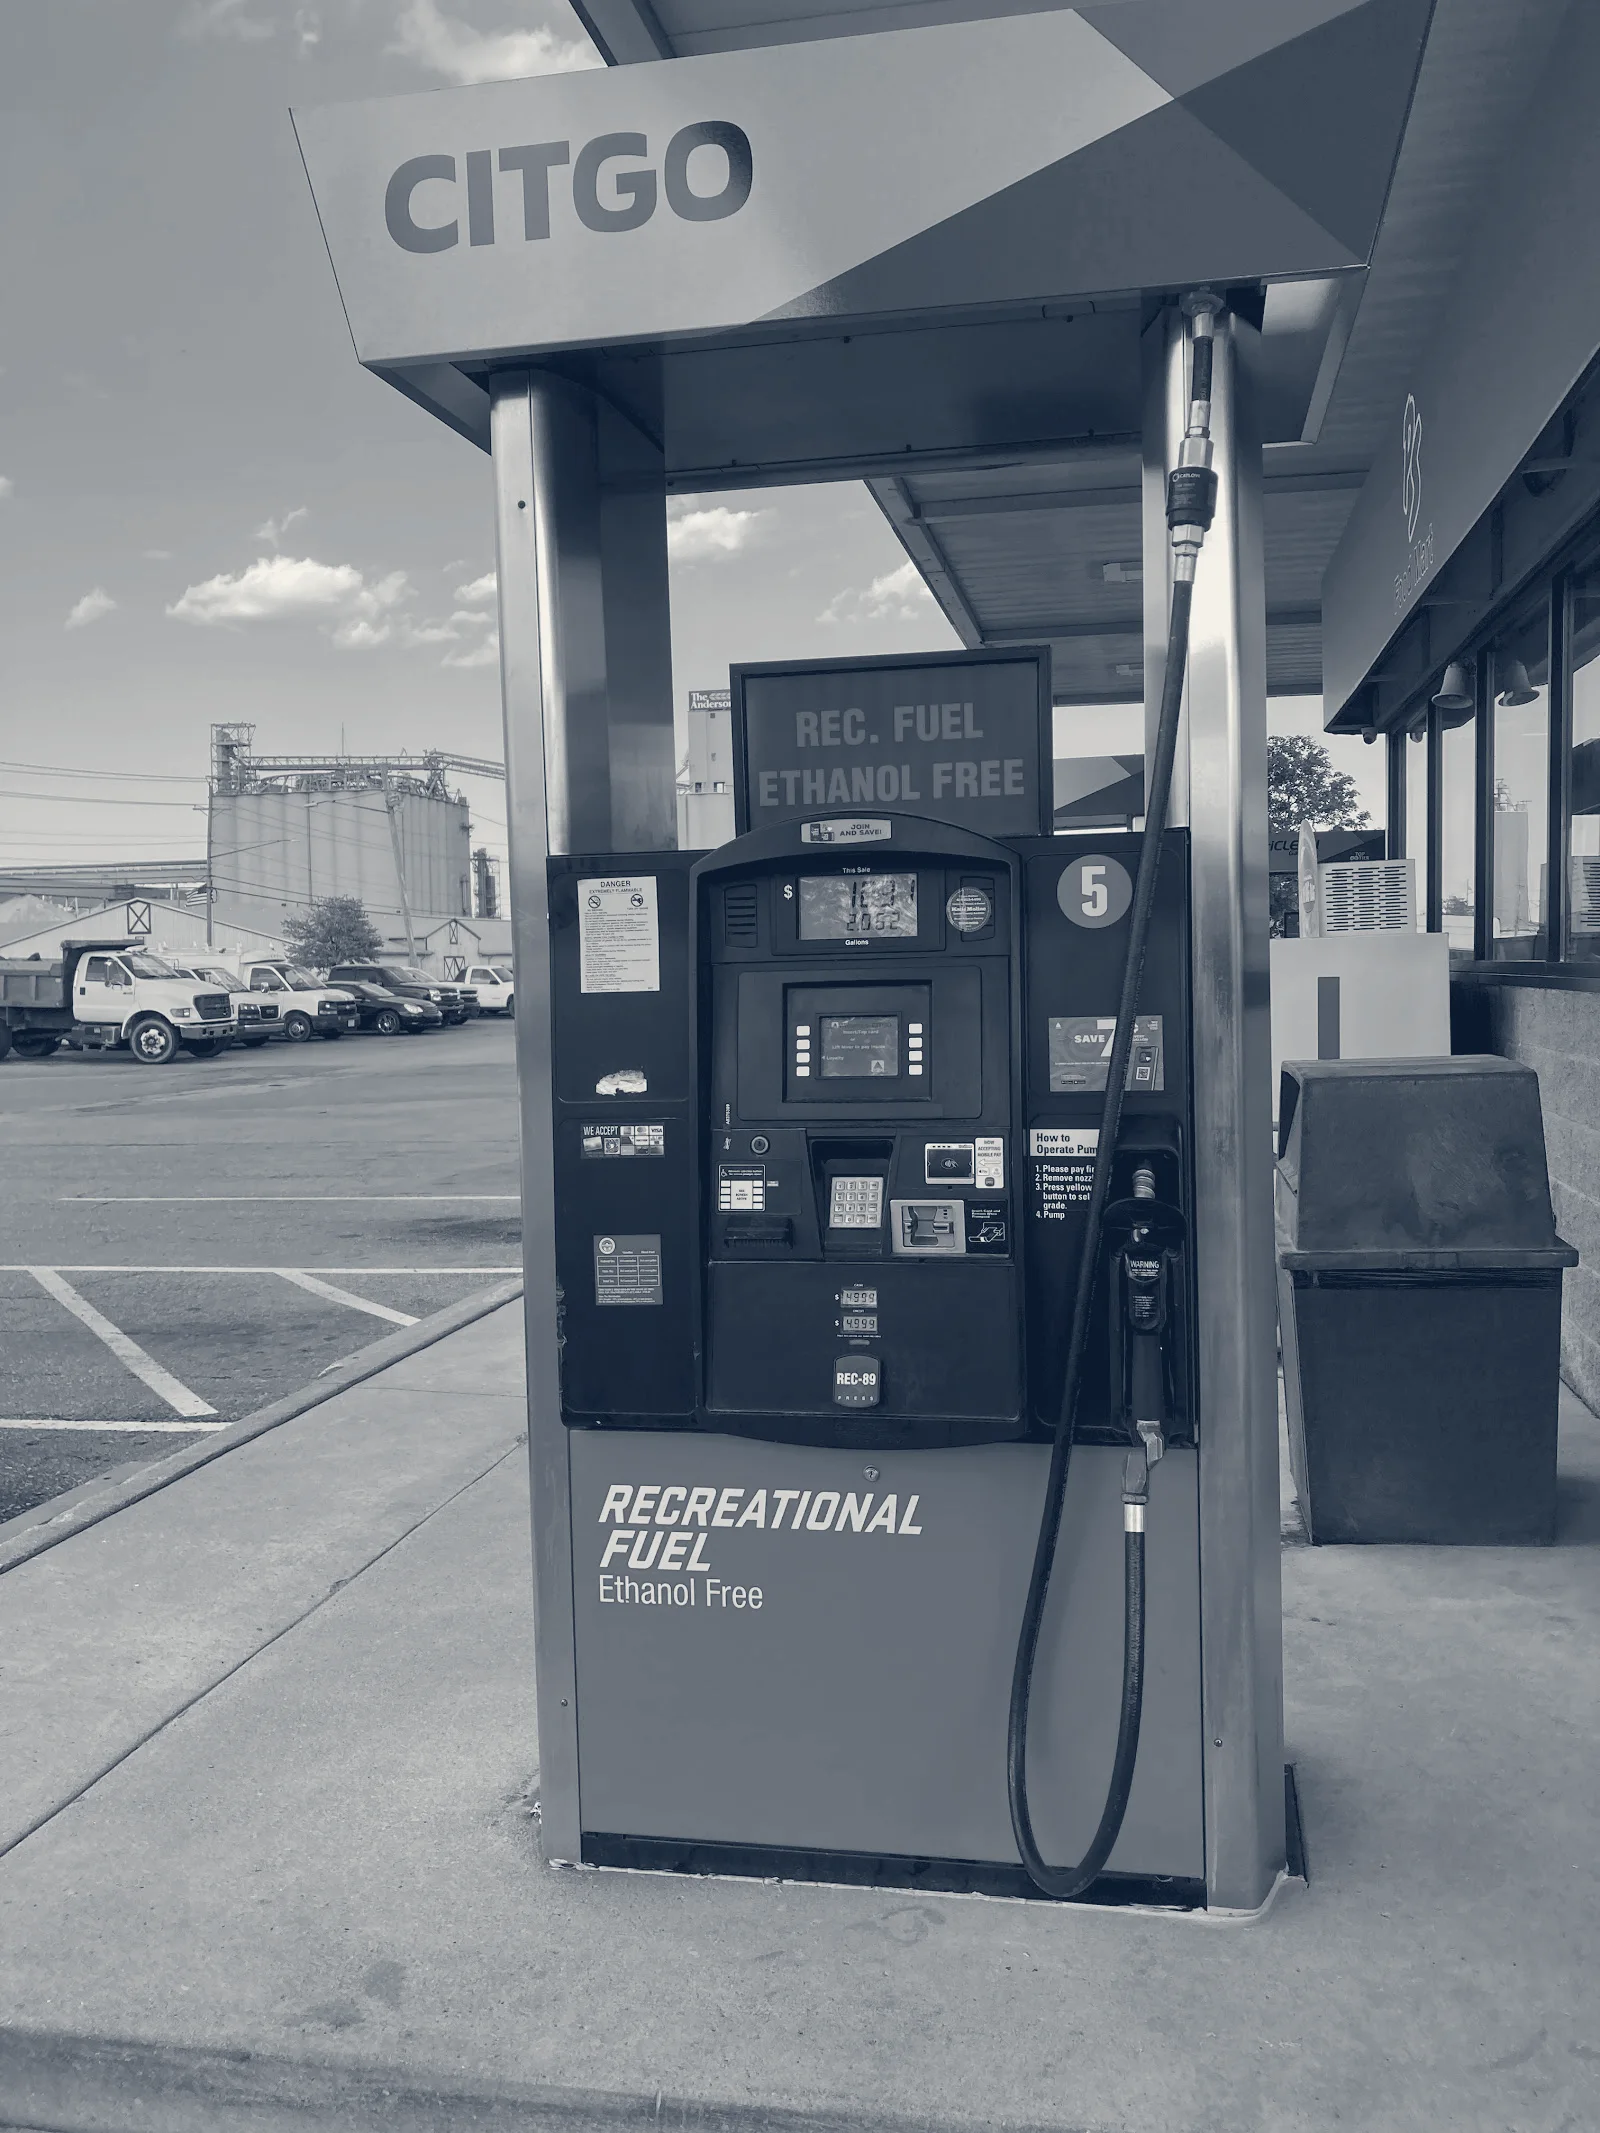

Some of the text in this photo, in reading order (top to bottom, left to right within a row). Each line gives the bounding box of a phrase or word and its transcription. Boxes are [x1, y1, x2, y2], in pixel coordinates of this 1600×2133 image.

[385, 120, 753, 254] CITGO
[691, 692, 708, 701] The
[690, 699, 731, 709] Anderso
[796, 703, 984, 747] REC. FUEL
[759, 759, 1025, 806] ETHANOL FREE
[600, 880, 631, 888] DANGER
[783, 884, 793, 900] $
[1081, 865, 1108, 917] 5
[1074, 1034, 1105, 1043] SAVE
[583, 1126, 619, 1136] WE ACCEPT
[1036, 1133, 1070, 1142] How to
[1036, 1144, 1097, 1156] Operate Pum
[1042, 1165, 1069, 1173] Please
[1070, 1166, 1085, 1174] pay
[1086, 1165, 1095, 1173] fir
[1035, 1183, 1092, 1192] 3. Press yellow
[1043, 1192, 1067, 1200] button
[1043, 1202, 1067, 1210] grade.
[1043, 1211, 1065, 1220] Pump
[1130, 1260, 1159, 1269] WARNING
[834, 1293, 840, 1301] $
[834, 1319, 840, 1327] $
[836, 1372, 876, 1386] REC-89
[598, 1484, 923, 1535] RECREATIONAL
[600, 1529, 711, 1571] FUEL
[599, 1574, 763, 1609] Ethanol Free
